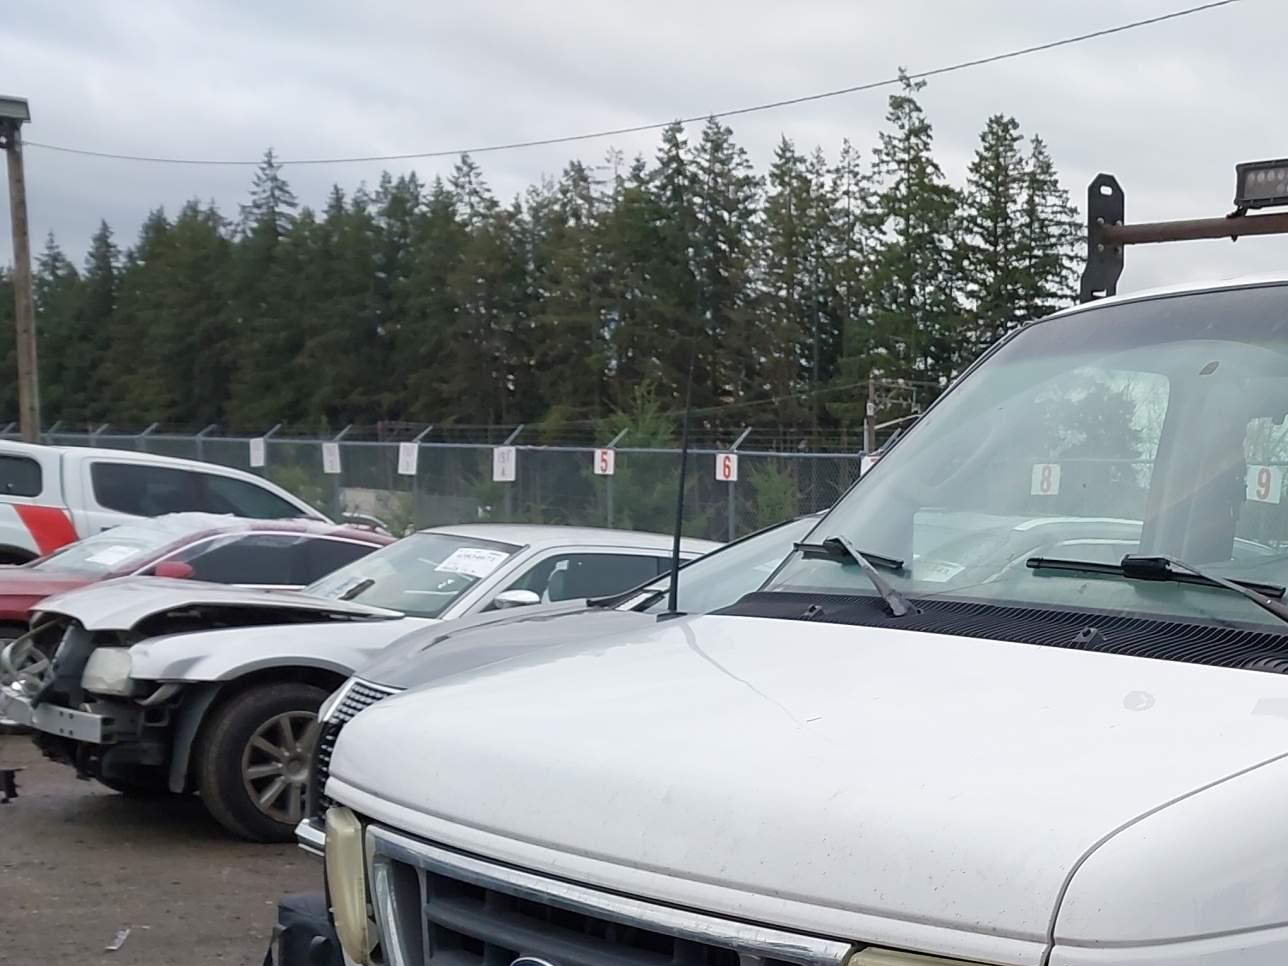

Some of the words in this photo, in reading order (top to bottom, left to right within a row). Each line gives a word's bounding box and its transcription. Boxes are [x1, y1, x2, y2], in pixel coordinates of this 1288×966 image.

[600, 451, 608, 473] 5
[723, 456, 731, 479] 6
[1040, 465, 1052, 493] 8
[1257, 468, 1271, 500] 9
